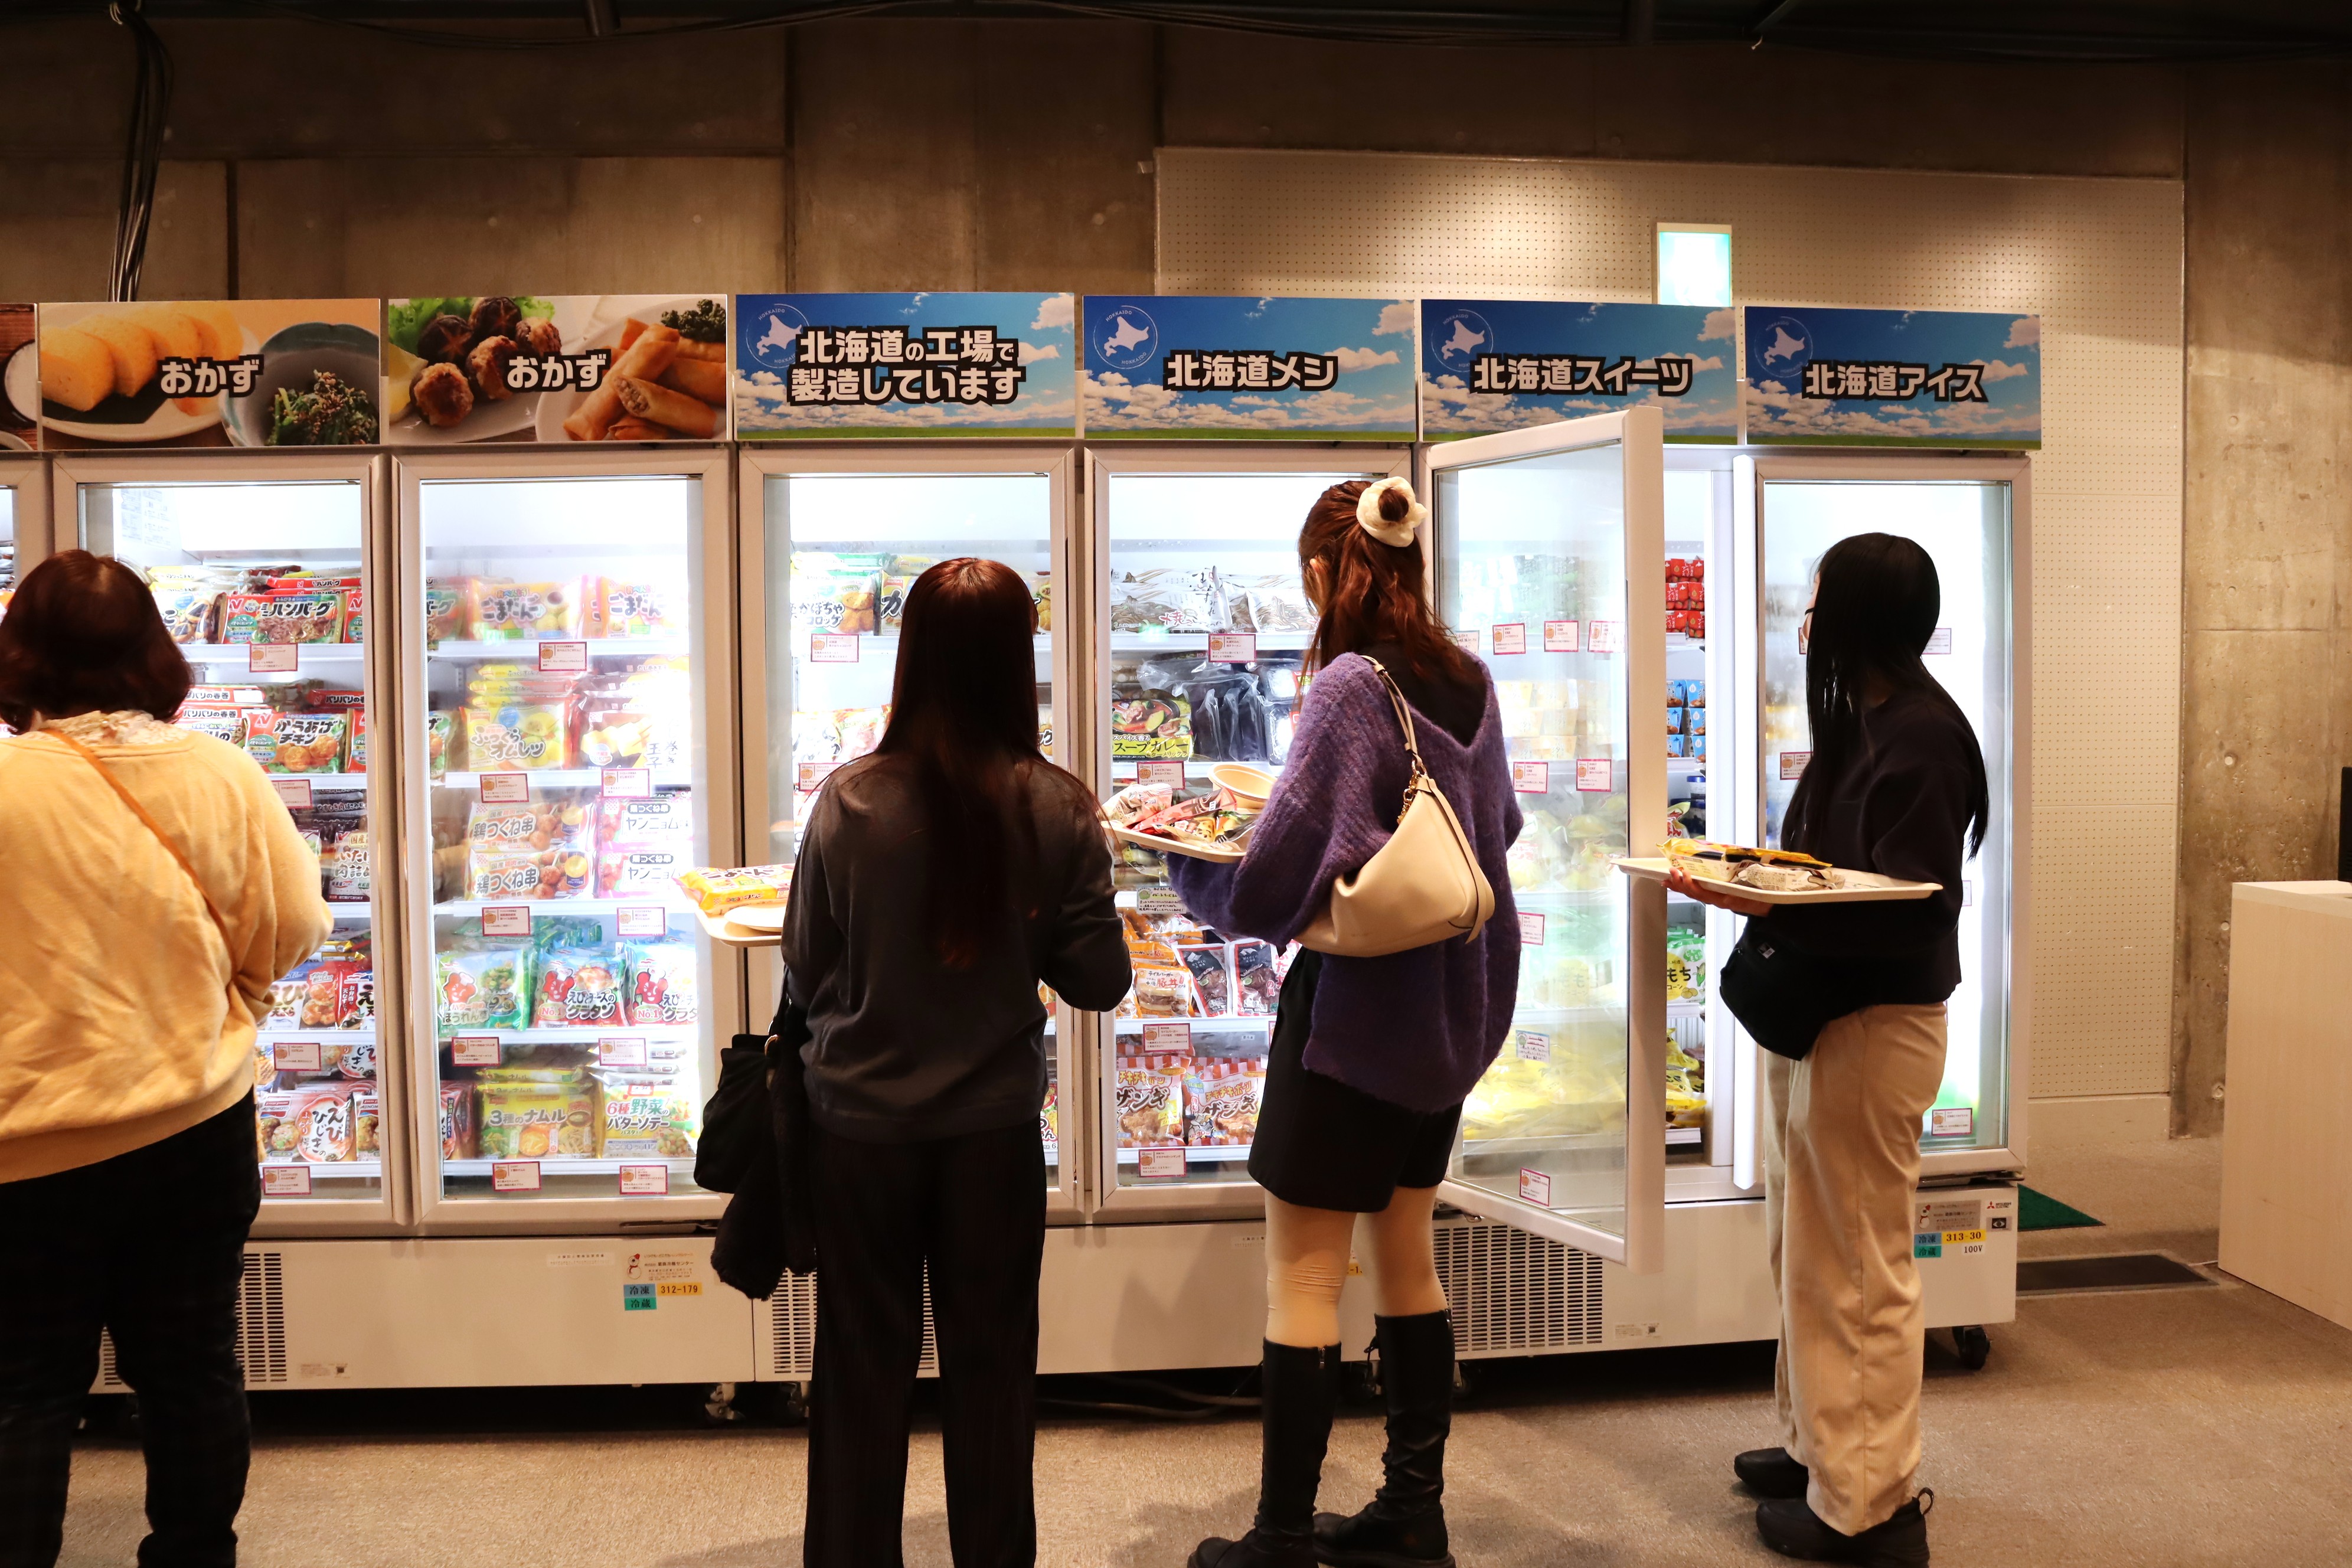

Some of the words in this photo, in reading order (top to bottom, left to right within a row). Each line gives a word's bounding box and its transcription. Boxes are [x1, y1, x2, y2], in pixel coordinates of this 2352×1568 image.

[757, 308, 786, 321] HOKKAIDO
[1105, 309, 1133, 322] HOKKAIDO
[800, 329, 1015, 364] 北海道の工場で
[773, 353, 798, 364] HOKKAI
[1121, 351, 1147, 365] HOKKAIDO
[160, 358, 260, 394] おかず
[507, 352, 607, 388] おかず
[1167, 354, 1334, 387] 北海道メシ
[1474, 357, 1690, 392] 北海道スイーツ
[790, 368, 1022, 402] 製造しています
[1805, 363, 1982, 398] 北海道アイス
[496, 587, 528, 598] おべんとう
[274, 720, 338, 734] からあげ
[279, 733, 317, 744] チキン
[471, 726, 519, 745] ふっくら
[490, 741, 544, 760] オムレツ
[1113, 740, 1189, 753] スープカレー
[473, 816, 534, 841] 鶏つくね串
[476, 867, 539, 894] 鶏つくね串
[541, 1007, 563, 1016] No.1
[566, 1003, 615, 1020] グラタン
[637, 1009, 658, 1020] No.1
[1118, 1070, 1165, 1085] チキチキボーン
[1116, 1087, 1170, 1110] ザンギ
[1205, 1082, 1253, 1102] チキチキボーン
[606, 1098, 669, 1115] 6種野菜の
[1202, 1094, 1257, 1118] ザンギ
[489, 1109, 567, 1125] 3種のナムル
[606, 1116, 669, 1130] バターソテー
[1918, 1236, 1936, 1244] 冷凍
[1946, 1231, 1982, 1242] 313-30
[1919, 1248, 1936, 1256] 冷蔵
[1964, 1245, 1983, 1253] 100V
[629, 1286, 650, 1296] 冷凍
[660, 1285, 698, 1294] 312-179
[631, 1298, 651, 1309] 冷蔵
